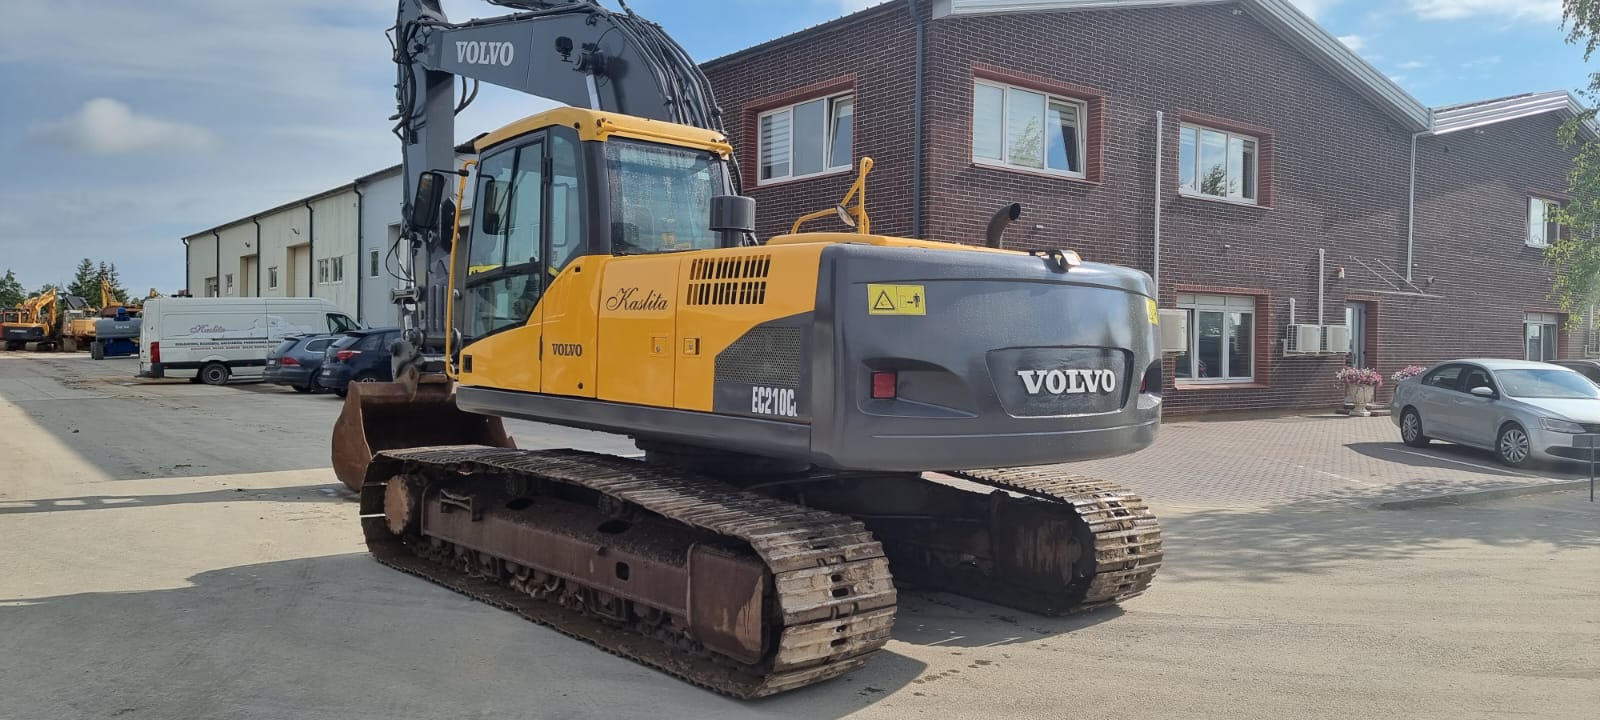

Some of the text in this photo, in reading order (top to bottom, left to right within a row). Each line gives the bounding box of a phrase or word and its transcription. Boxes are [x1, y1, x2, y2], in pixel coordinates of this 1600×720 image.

[456, 41, 514, 66] VOLVO
[606, 287, 668, 311] Kaslita
[552, 343, 582, 357] VOLVO
[1017, 368, 1116, 394] VOLVO
